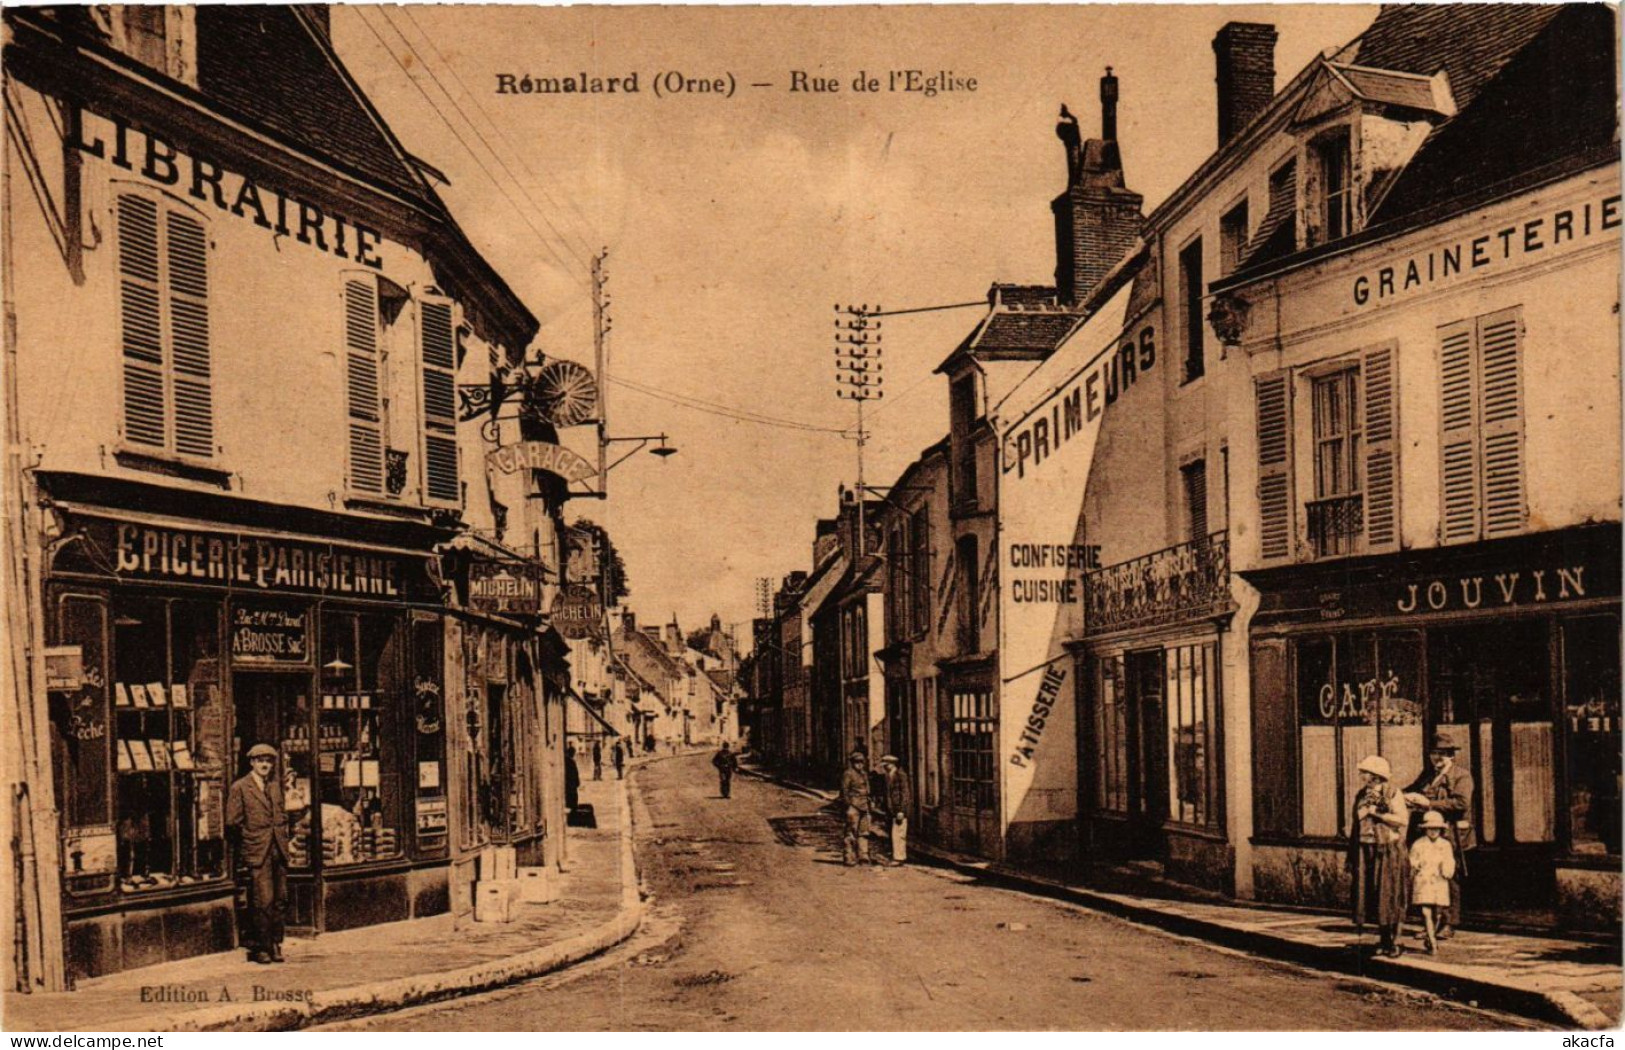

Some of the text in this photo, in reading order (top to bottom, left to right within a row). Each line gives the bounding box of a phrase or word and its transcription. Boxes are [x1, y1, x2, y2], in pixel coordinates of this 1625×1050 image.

[64, 106, 384, 270] LIBRAIRIE
[1353, 194, 1622, 306] GRAINETERIE
[494, 443, 591, 483] GARAGE
[114, 524, 398, 596] EPICERIE PARISIENNE
[1010, 543, 1102, 569] CONFISERIE
[470, 577, 535, 597] MICHELIN
[1012, 579, 1078, 604] CUISINE
[1397, 565, 1585, 612] JOUVIN
[1010, 663, 1067, 769] PATISSERIE
